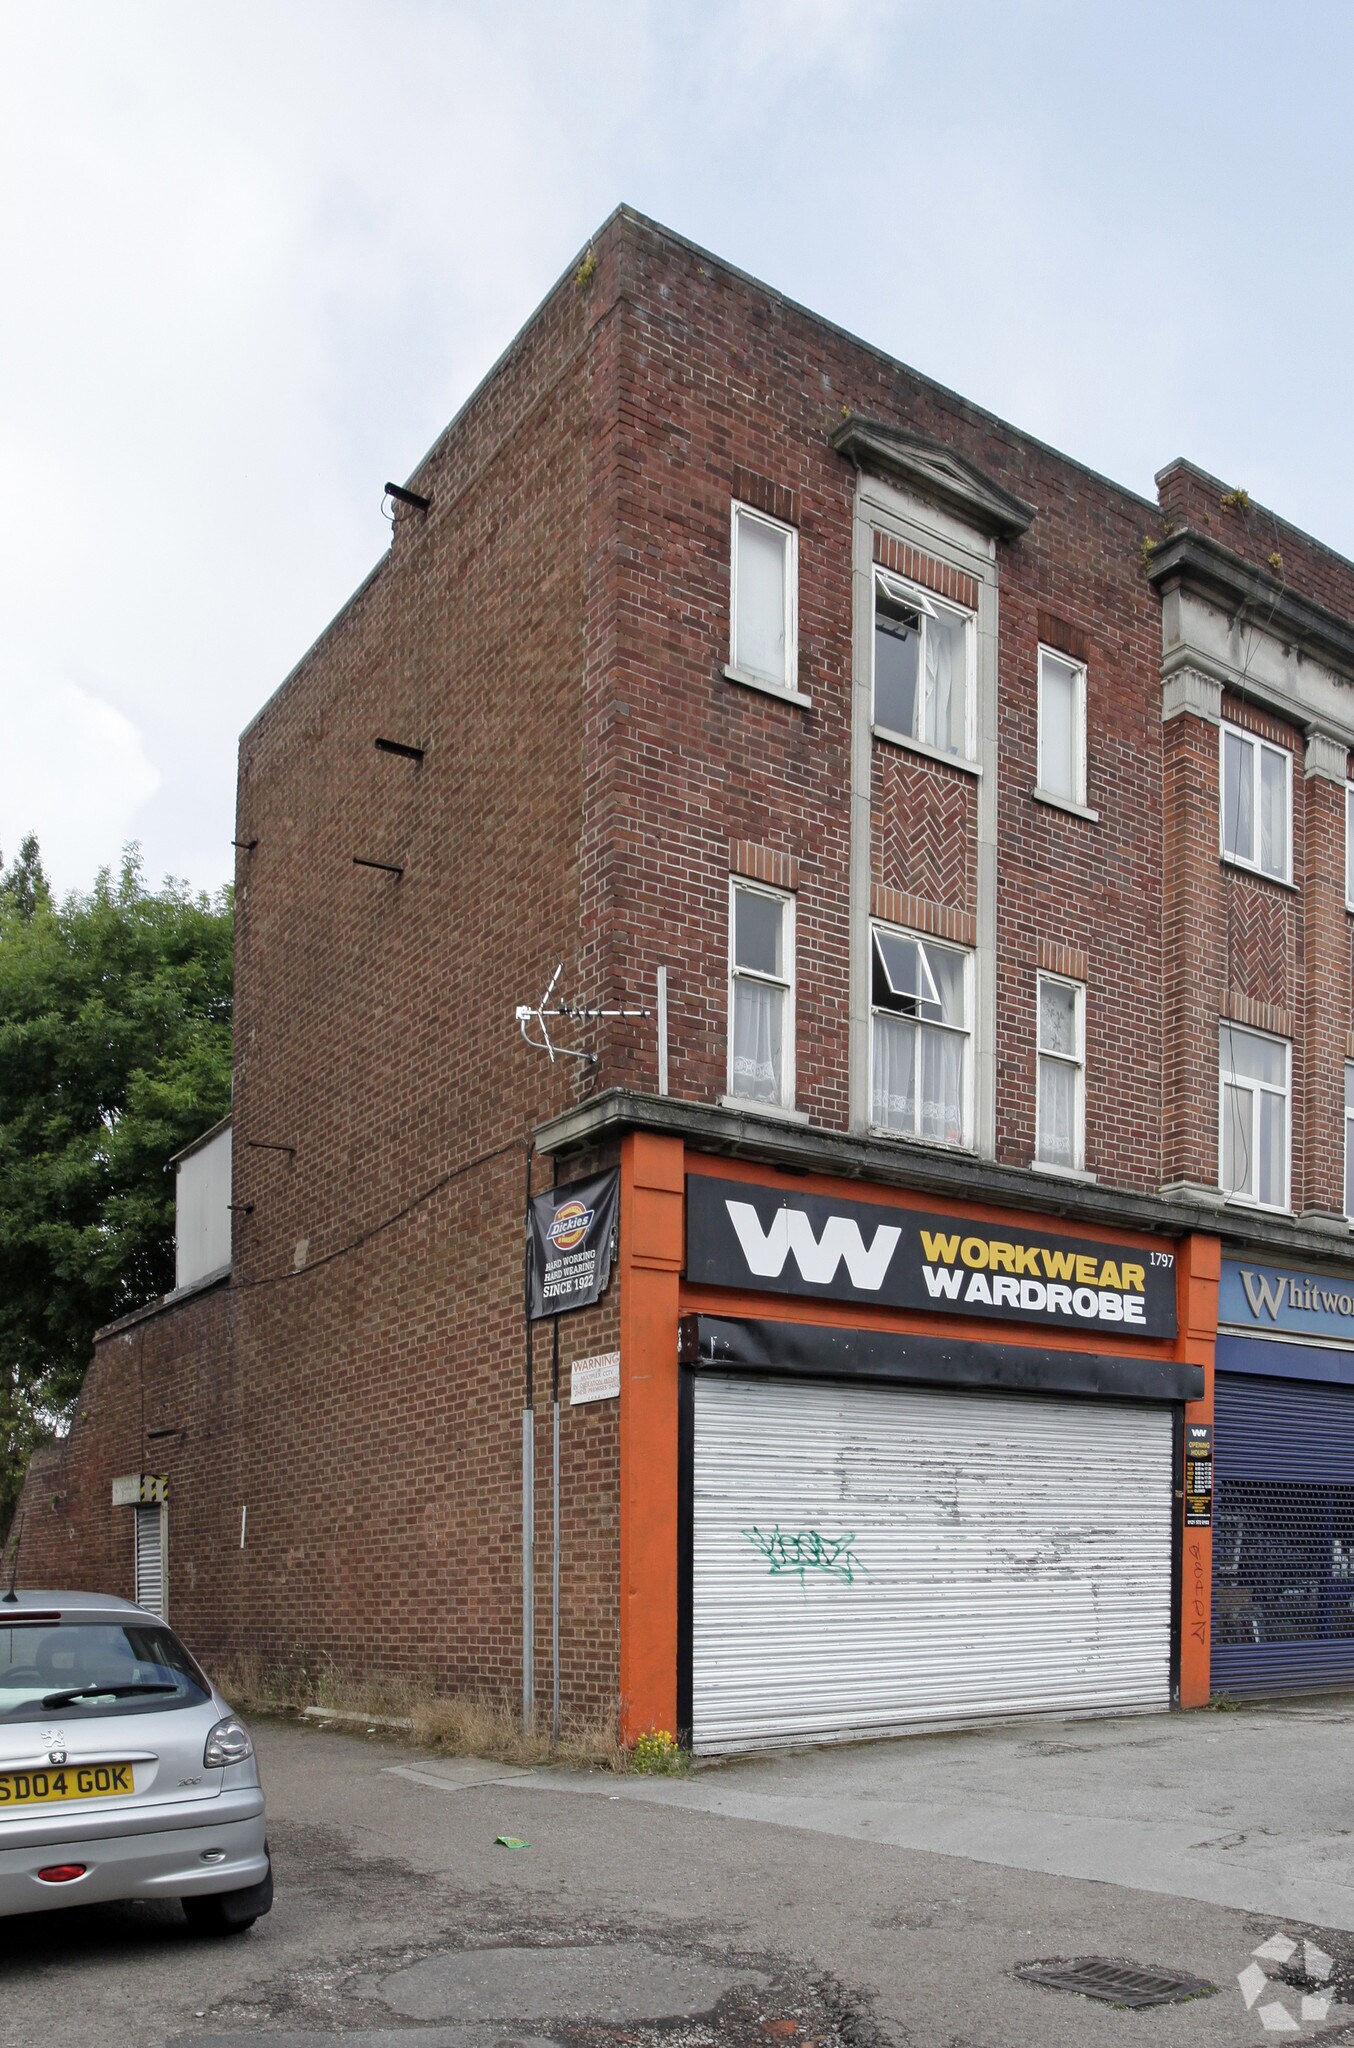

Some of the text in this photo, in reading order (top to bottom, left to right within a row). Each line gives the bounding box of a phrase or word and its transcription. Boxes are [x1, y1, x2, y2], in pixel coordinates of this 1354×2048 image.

[551, 1215, 589, 1236] Dickies
[545, 1249, 596, 1272] HARD WORKING
[919, 1230, 1146, 1292] WORKWEAR
[1149, 1251, 1175, 1269] 1797
[544, 1261, 595, 1282] HARD WEARING
[543, 1274, 594, 1298] SINCE 1922
[922, 1265, 1147, 1325] WARDROBE
[573, 1352, 619, 1372] WARNING
[1188, 1441, 1210, 1449] OPENING
[1190, 1449, 1208, 1457] HOURS
[77, 1767, 129, 1793] GOK
[176, 1776, 202, 1788] 206
